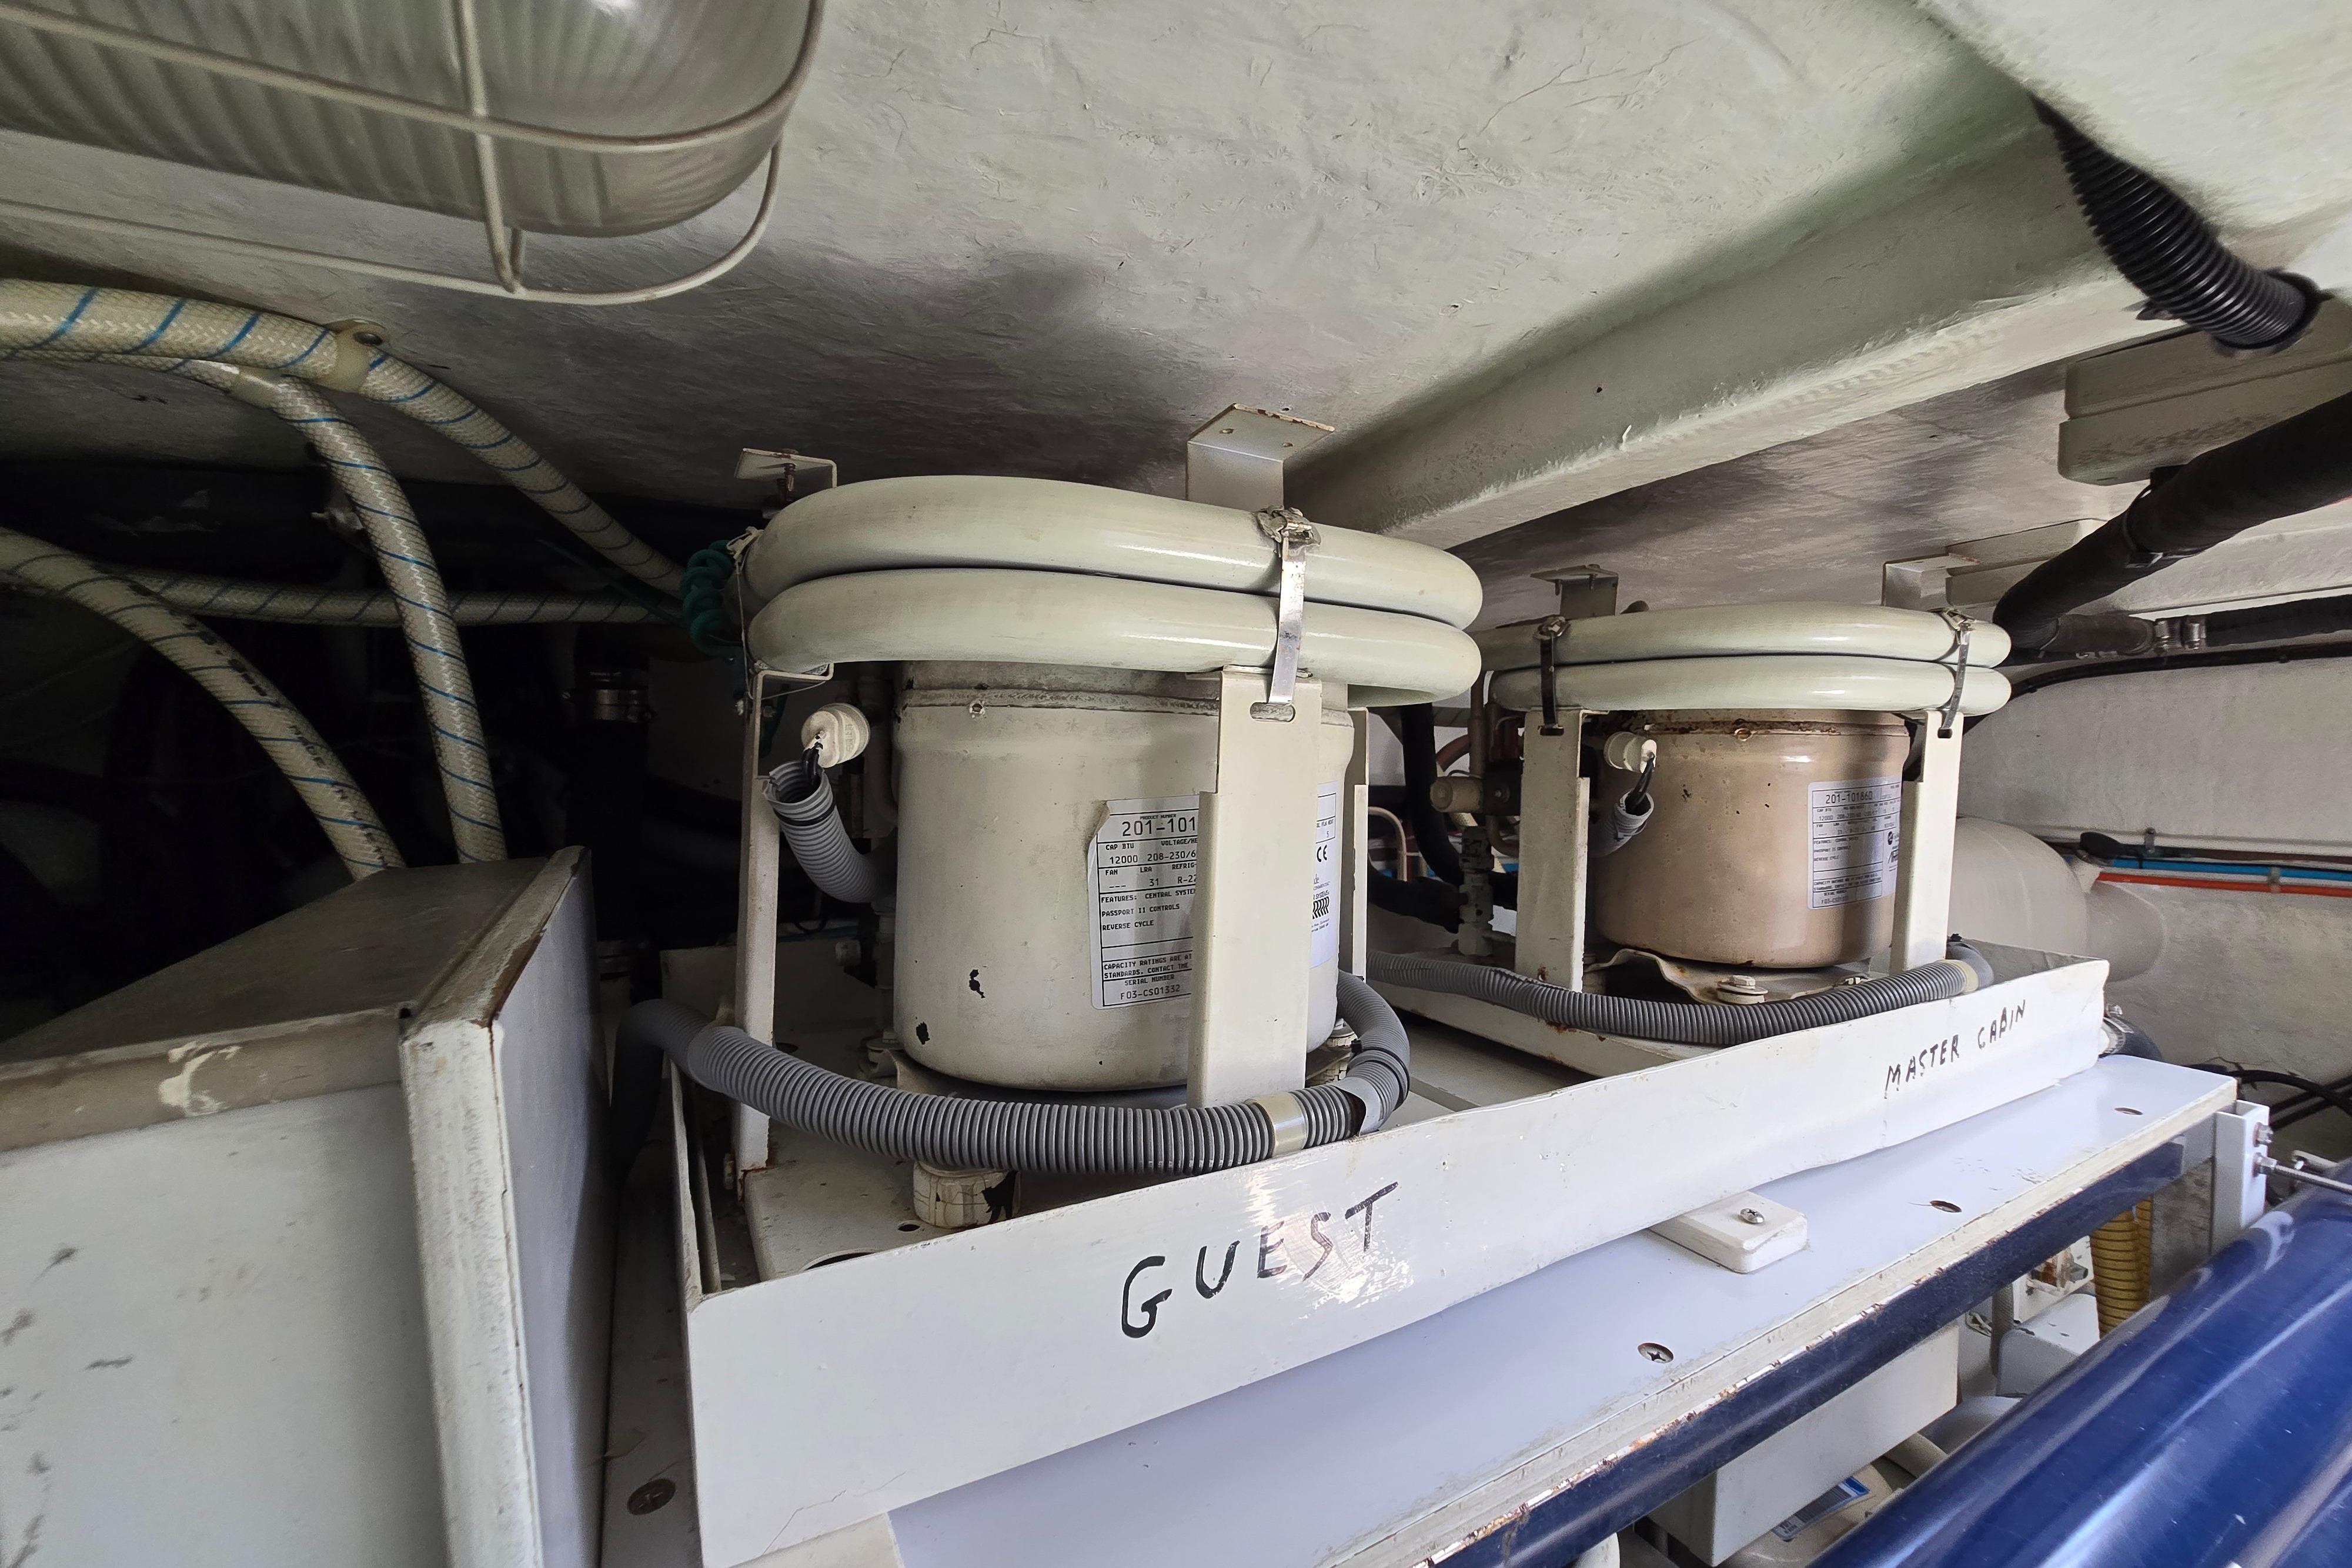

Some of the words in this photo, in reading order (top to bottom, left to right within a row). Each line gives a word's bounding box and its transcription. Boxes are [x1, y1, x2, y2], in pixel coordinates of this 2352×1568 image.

[1109, 855, 1138, 864] 12000
[1149, 878, 1159, 887] 31
[1101, 895, 1137, 903] FEATURES:
[1145, 891, 1172, 899] CENTRAL
[1101, 908, 1134, 917] PASSPORT
[1150, 904, 1180, 912] CONTROLS
[1102, 922, 1131, 931] REVERSE
[1104, 961, 1136, 970] CAPACITY
[1140, 957, 1167, 966] RATINGS
[1104, 969, 1144, 979] STANDARDS.
[1147, 964, 1174, 974] CONTACT
[1151, 974, 1175, 982] NUMBER
[1884, 1034, 1960, 1099] MASTER
[1977, 999, 2026, 1049] CABIN
[1121, 1181, 1399, 1339] GUEST
